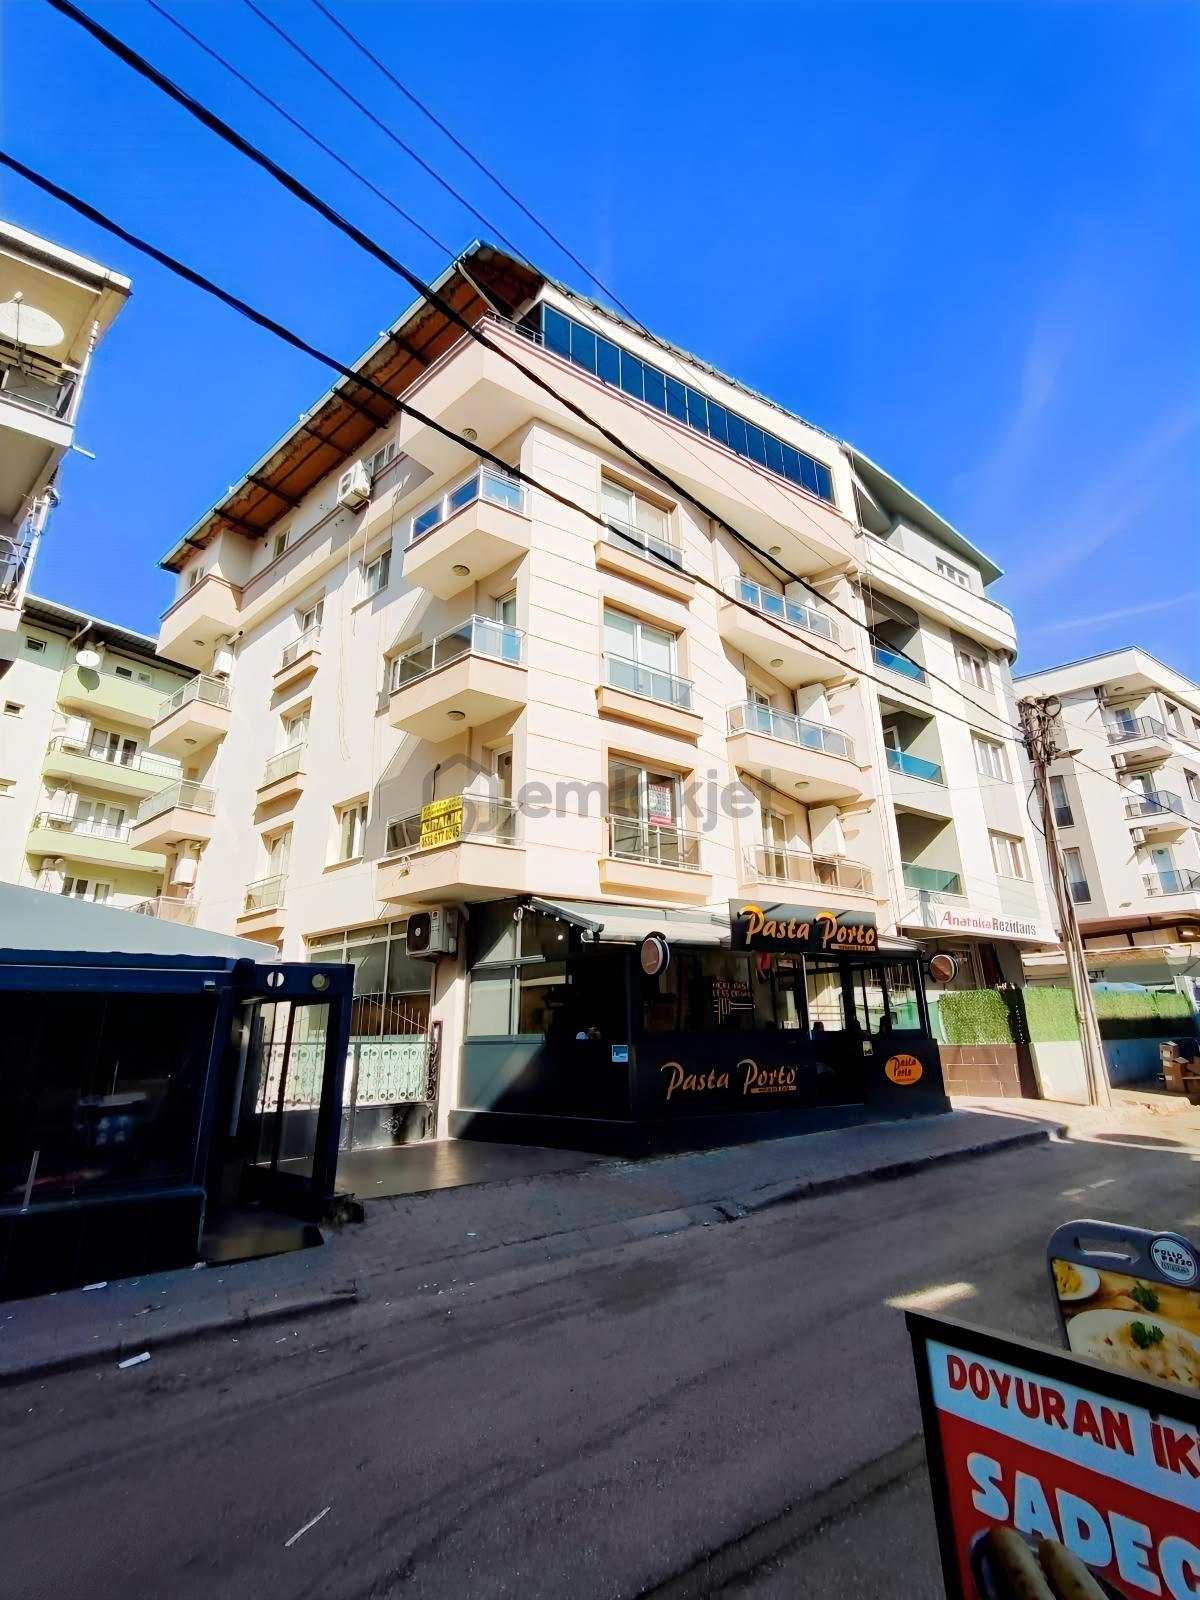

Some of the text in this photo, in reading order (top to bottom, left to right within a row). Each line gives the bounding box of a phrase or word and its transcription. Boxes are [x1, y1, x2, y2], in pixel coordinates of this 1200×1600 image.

[737, 904, 876, 949] Pasta Porto
[992, 918, 1037, 936] Rezidans
[660, 1058, 797, 1101] Pasta Porto
[1154, 1248, 1183, 1260] POLLO
[946, 1354, 1135, 1456] DOYURAN
